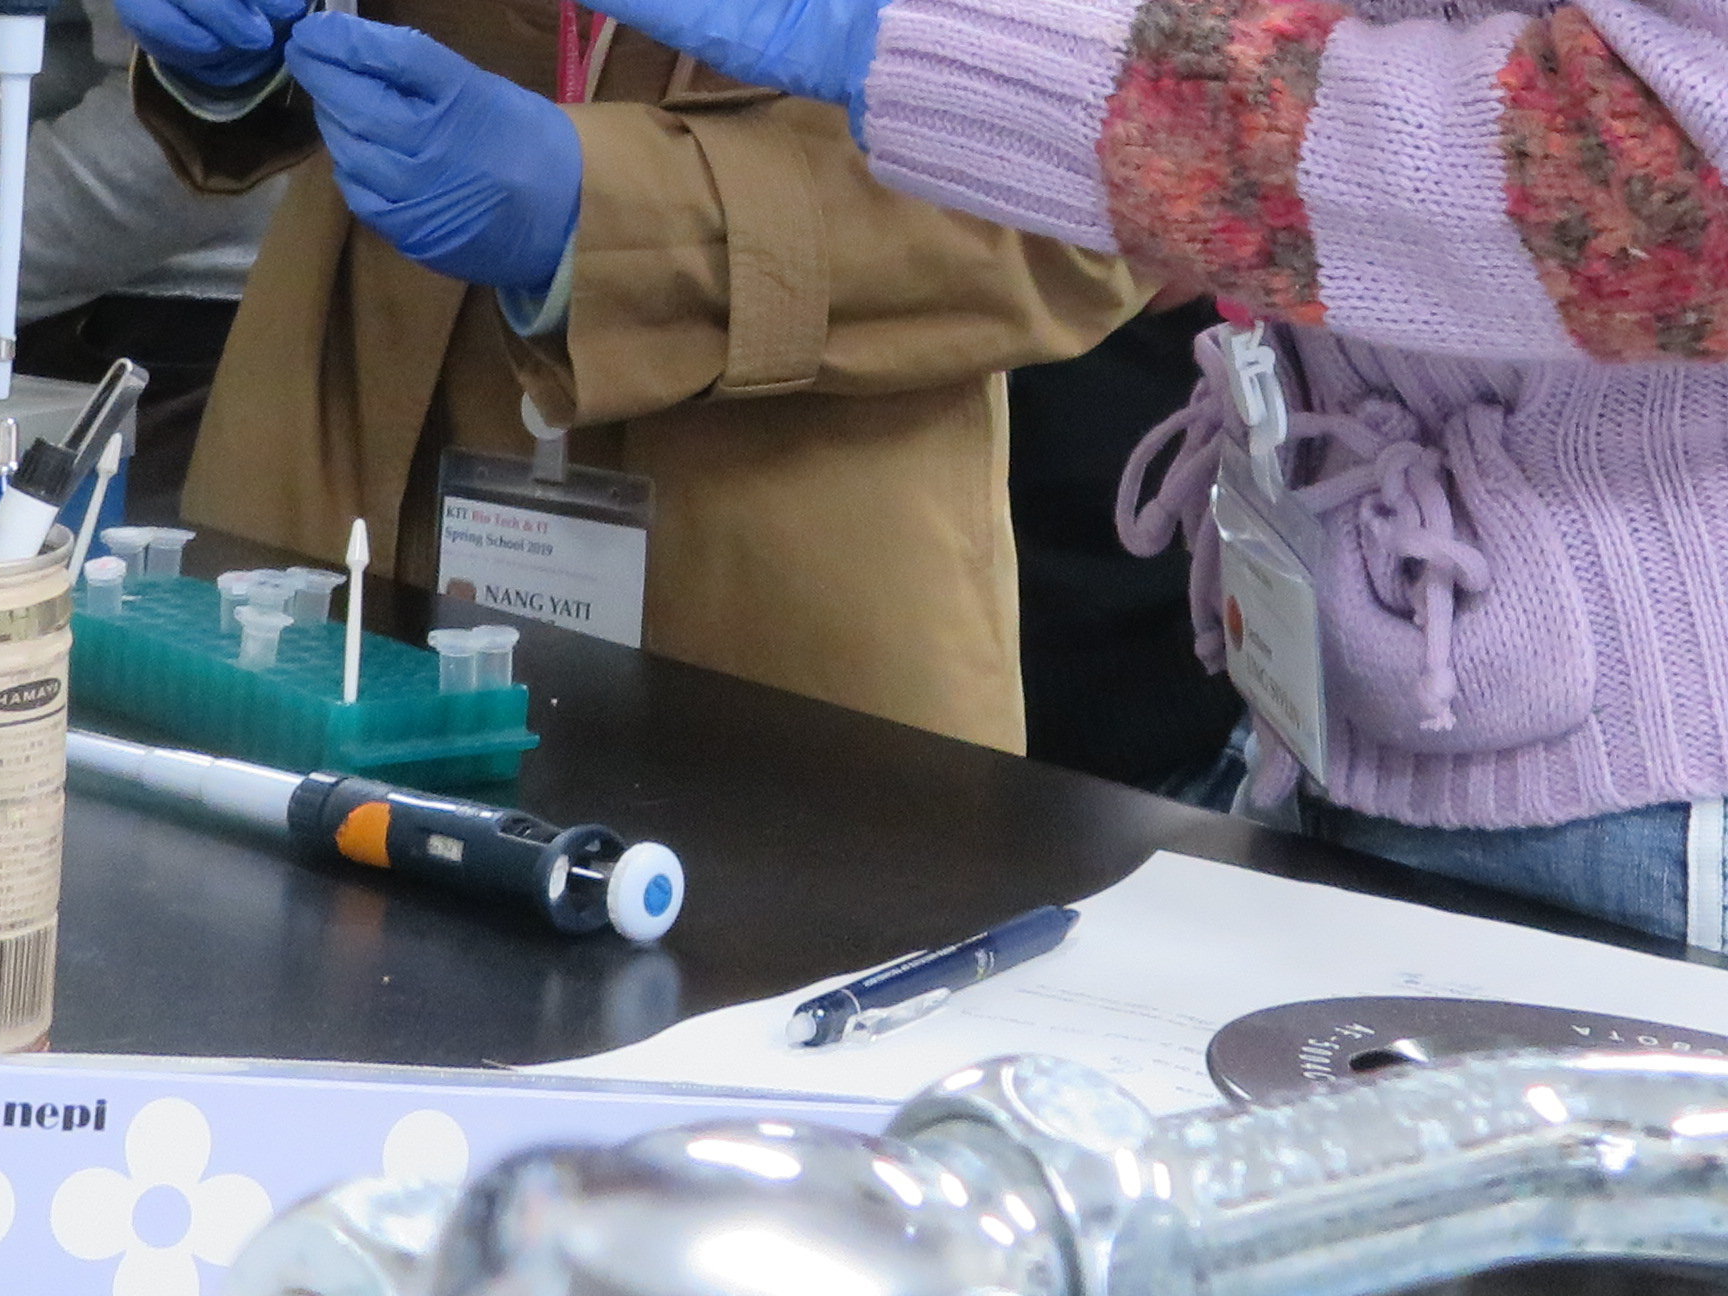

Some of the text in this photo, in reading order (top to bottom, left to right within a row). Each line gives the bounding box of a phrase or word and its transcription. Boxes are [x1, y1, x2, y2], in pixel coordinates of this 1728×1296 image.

[444, 526, 554, 557] Spring School 2019
[484, 584, 592, 621] NANG YATI
[2, 1098, 108, 1132] nepi
